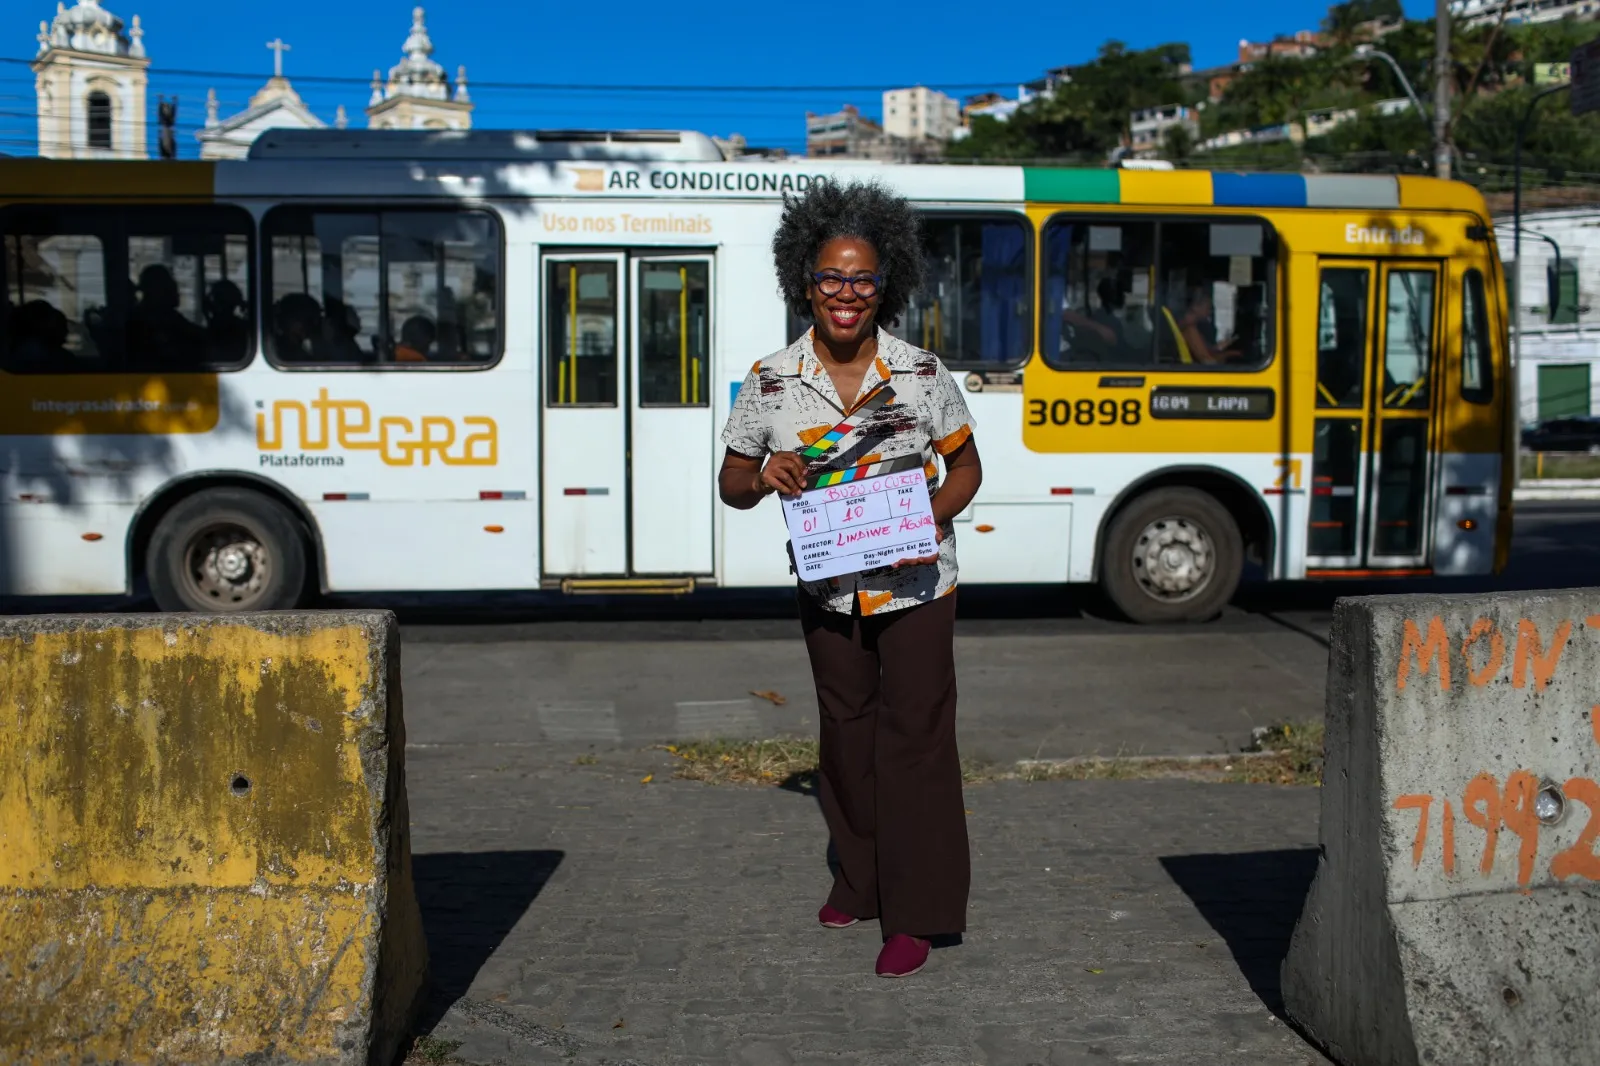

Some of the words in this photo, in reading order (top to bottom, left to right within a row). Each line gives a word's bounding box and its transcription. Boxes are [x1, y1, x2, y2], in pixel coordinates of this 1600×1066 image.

[608, 170, 640, 189] AR
[649, 170, 828, 192] CONDICIONADO
[543, 213, 578, 232] Uso
[582, 216, 616, 233] nos
[620, 213, 712, 234] Terminais
[1345, 223, 1424, 245] Entrada
[1207, 396, 1249, 411] LAPA
[1028, 399, 1141, 426] 30898
[259, 454, 345, 467] Plataforma
[897, 487, 914, 495] TAKE
[792, 500, 811, 509] PROD.
[845, 497, 866, 506] SCENE
[899, 498, 912, 513] 4
[802, 507, 818, 515] ROLL
[842, 506, 865, 522] 10
[801, 540, 834, 550] DIRECTOR:
[906, 544, 917, 552] Ext
[918, 541, 932, 549] Mos
[803, 551, 832, 561] CAMERA:
[805, 563, 824, 572] DATE:
[865, 559, 881, 567] Filter
